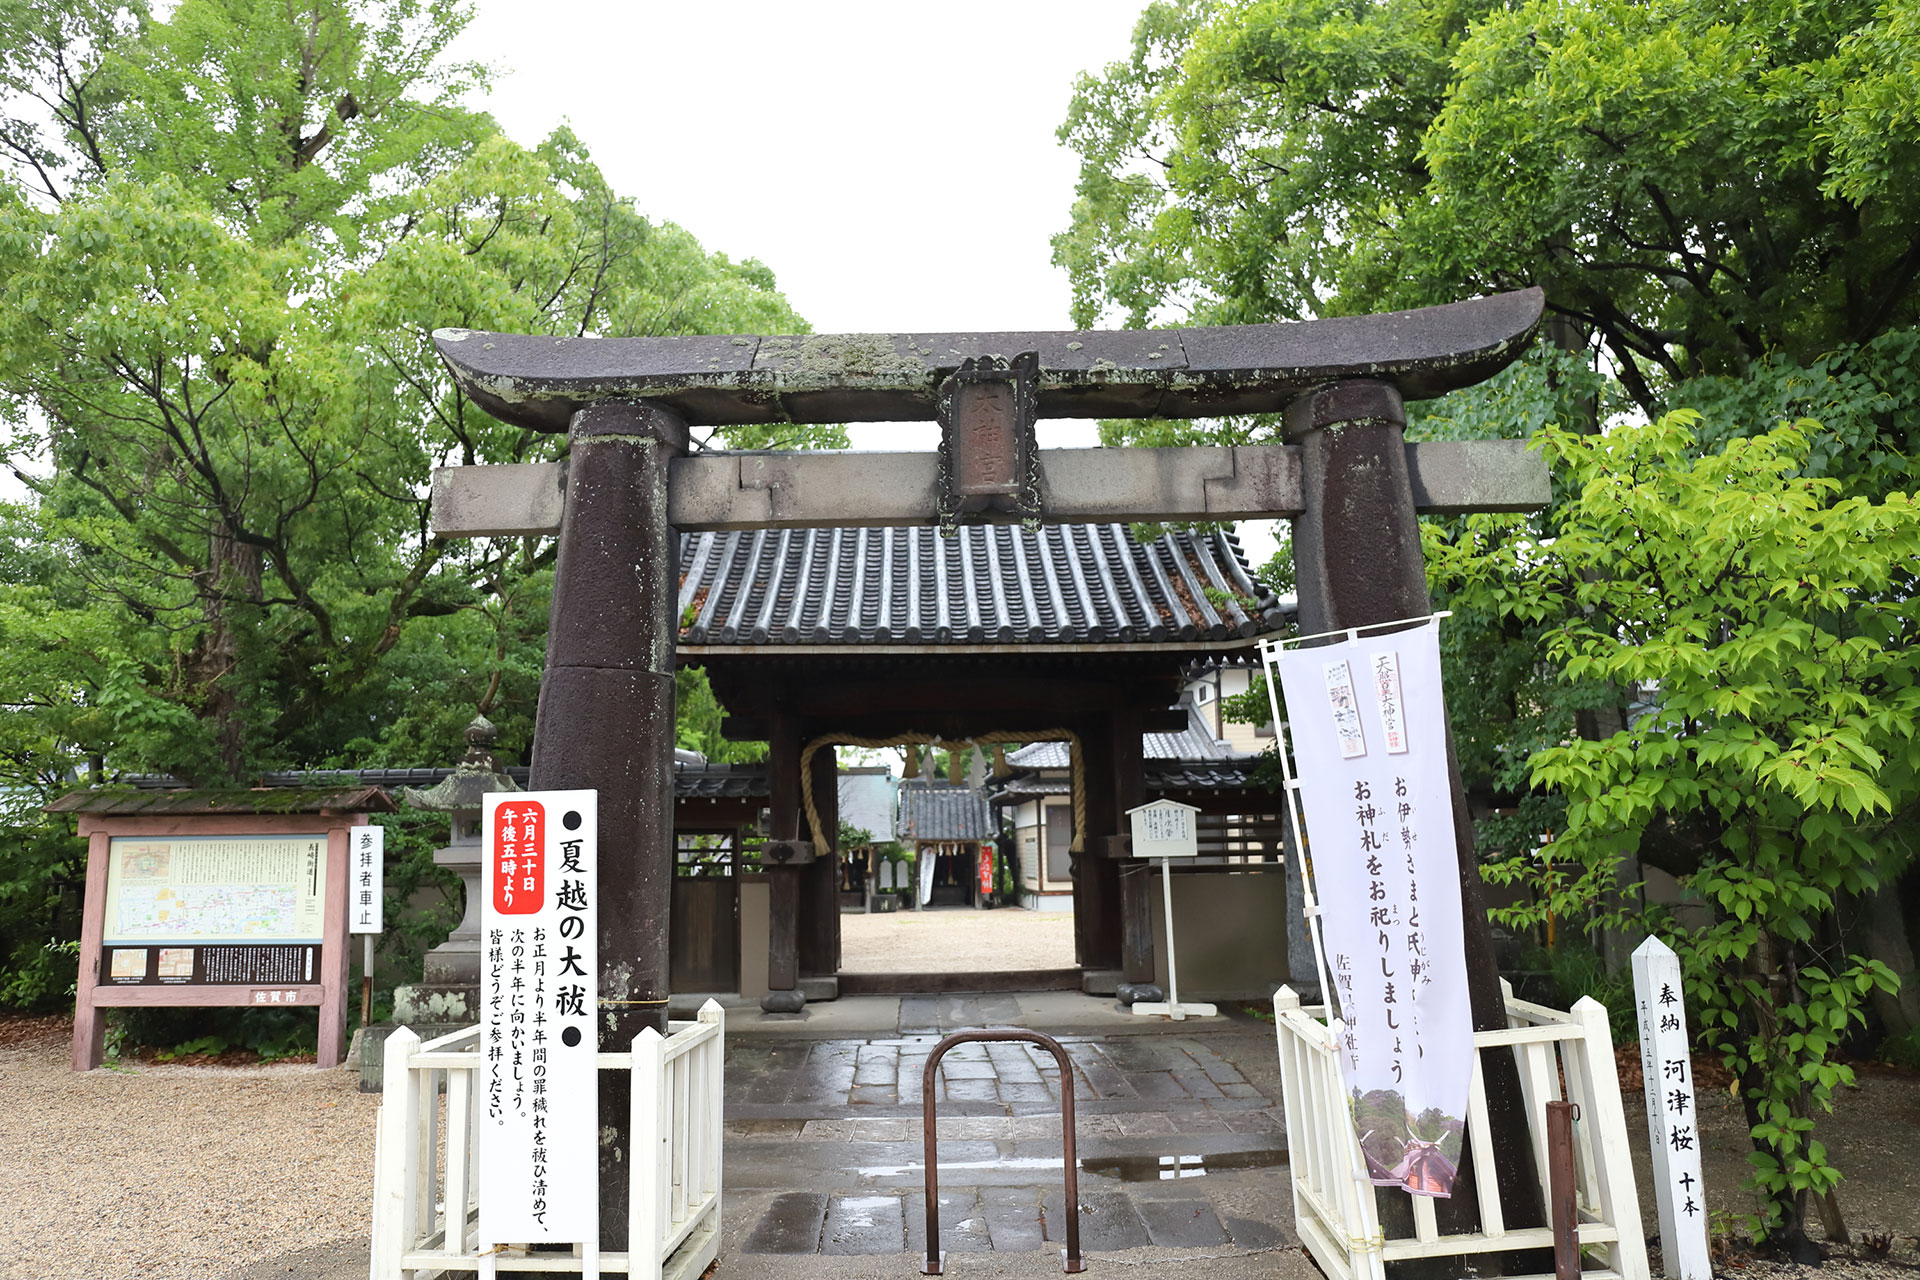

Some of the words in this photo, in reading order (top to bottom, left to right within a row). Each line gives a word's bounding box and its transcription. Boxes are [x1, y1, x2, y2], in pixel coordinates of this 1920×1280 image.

[359, 833, 373, 925] 参拝者車止
[500, 808, 518, 908] 午後五時より
[521, 807, 538, 892] 六月三十日
[555, 838, 588, 1017] 夏越の大祓
[255, 990, 297, 1003] 佐賀市
[488, 928, 504, 1126] 皆様どうぞご参拝ください。
[510, 928, 526, 1118] 次の半年に向かいましょう。
[1658, 982, 1680, 1032] 奉納
[1664, 1058, 1695, 1152] 河津桜
[1678, 1171, 1700, 1217] 十本
